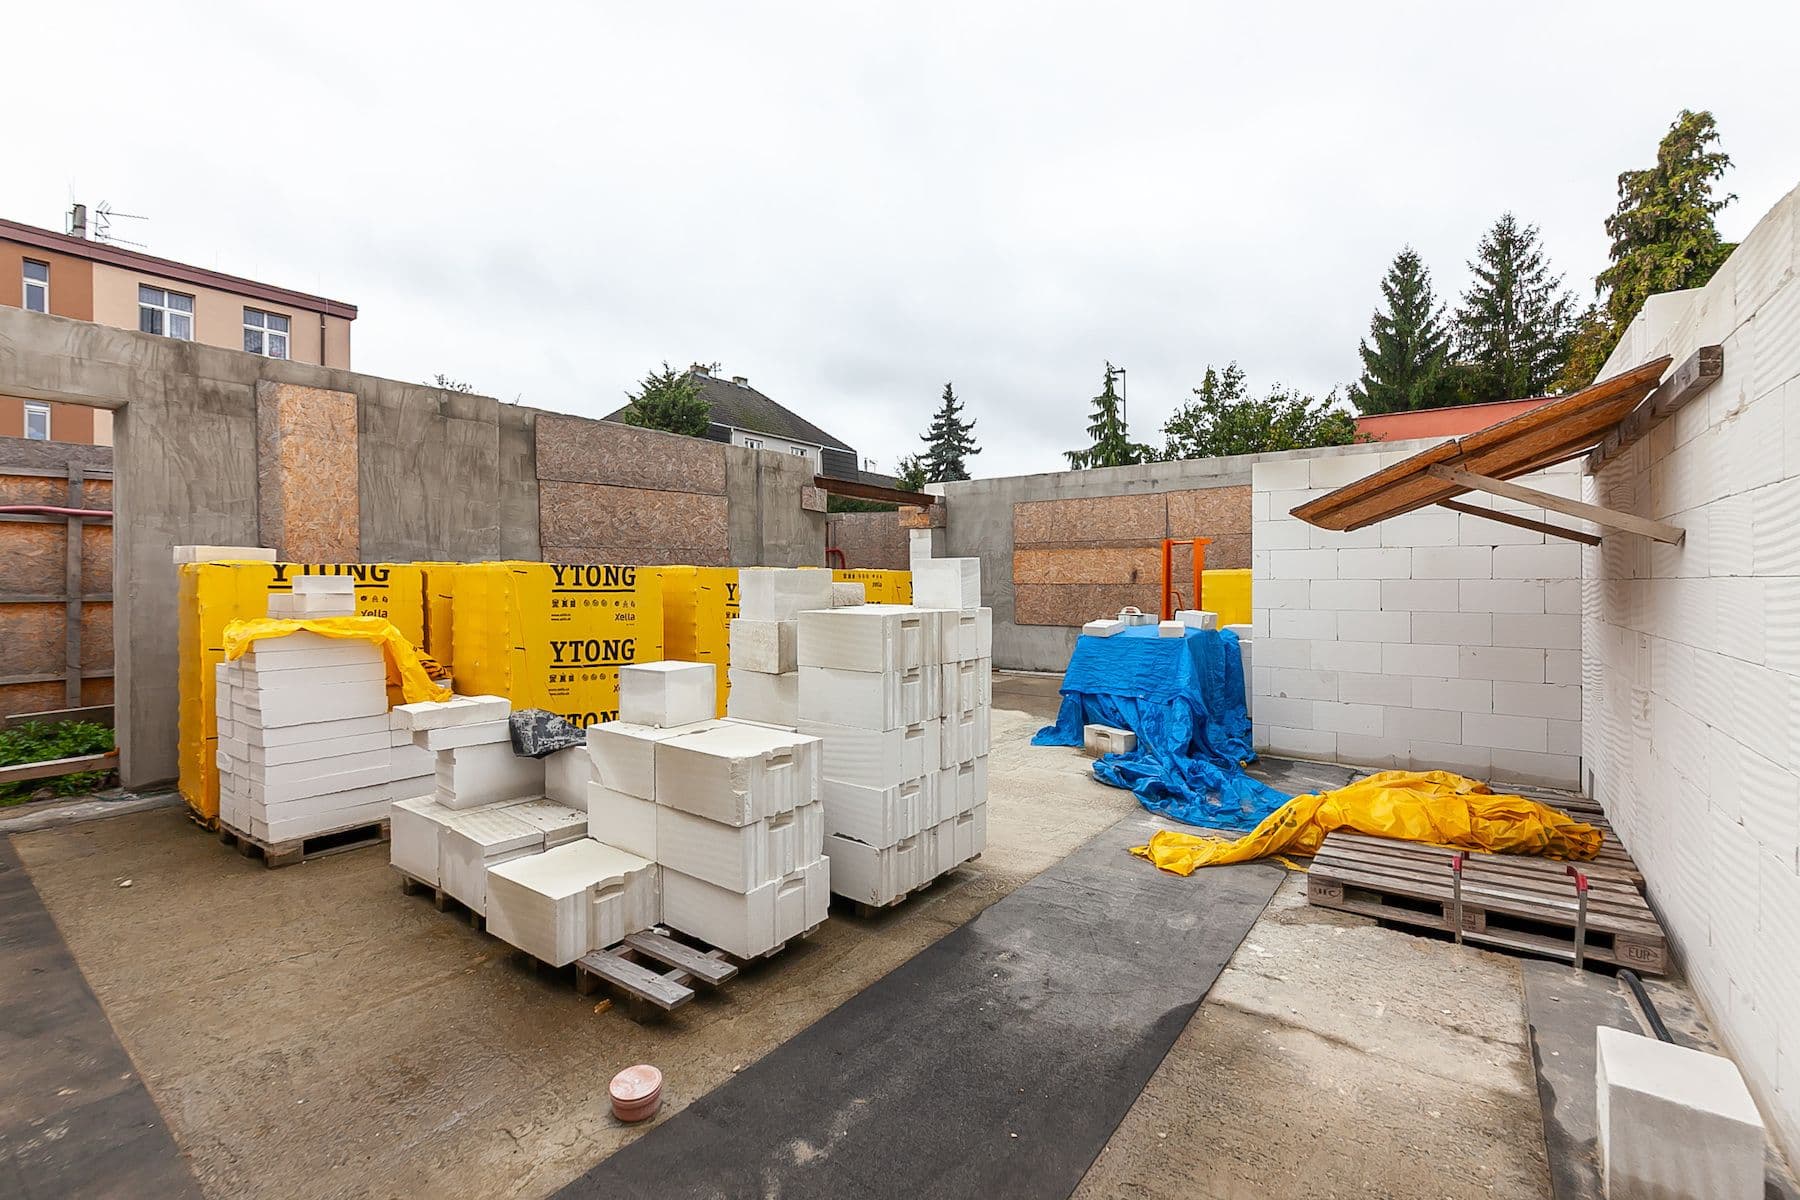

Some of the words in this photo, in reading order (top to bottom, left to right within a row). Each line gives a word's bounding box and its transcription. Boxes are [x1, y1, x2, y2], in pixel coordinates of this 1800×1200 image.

[550, 565, 636, 586] YTONG
[615, 613, 636, 621] Xella
[550, 639, 636, 662] YTONG
[1628, 947, 1650, 960] EUR
